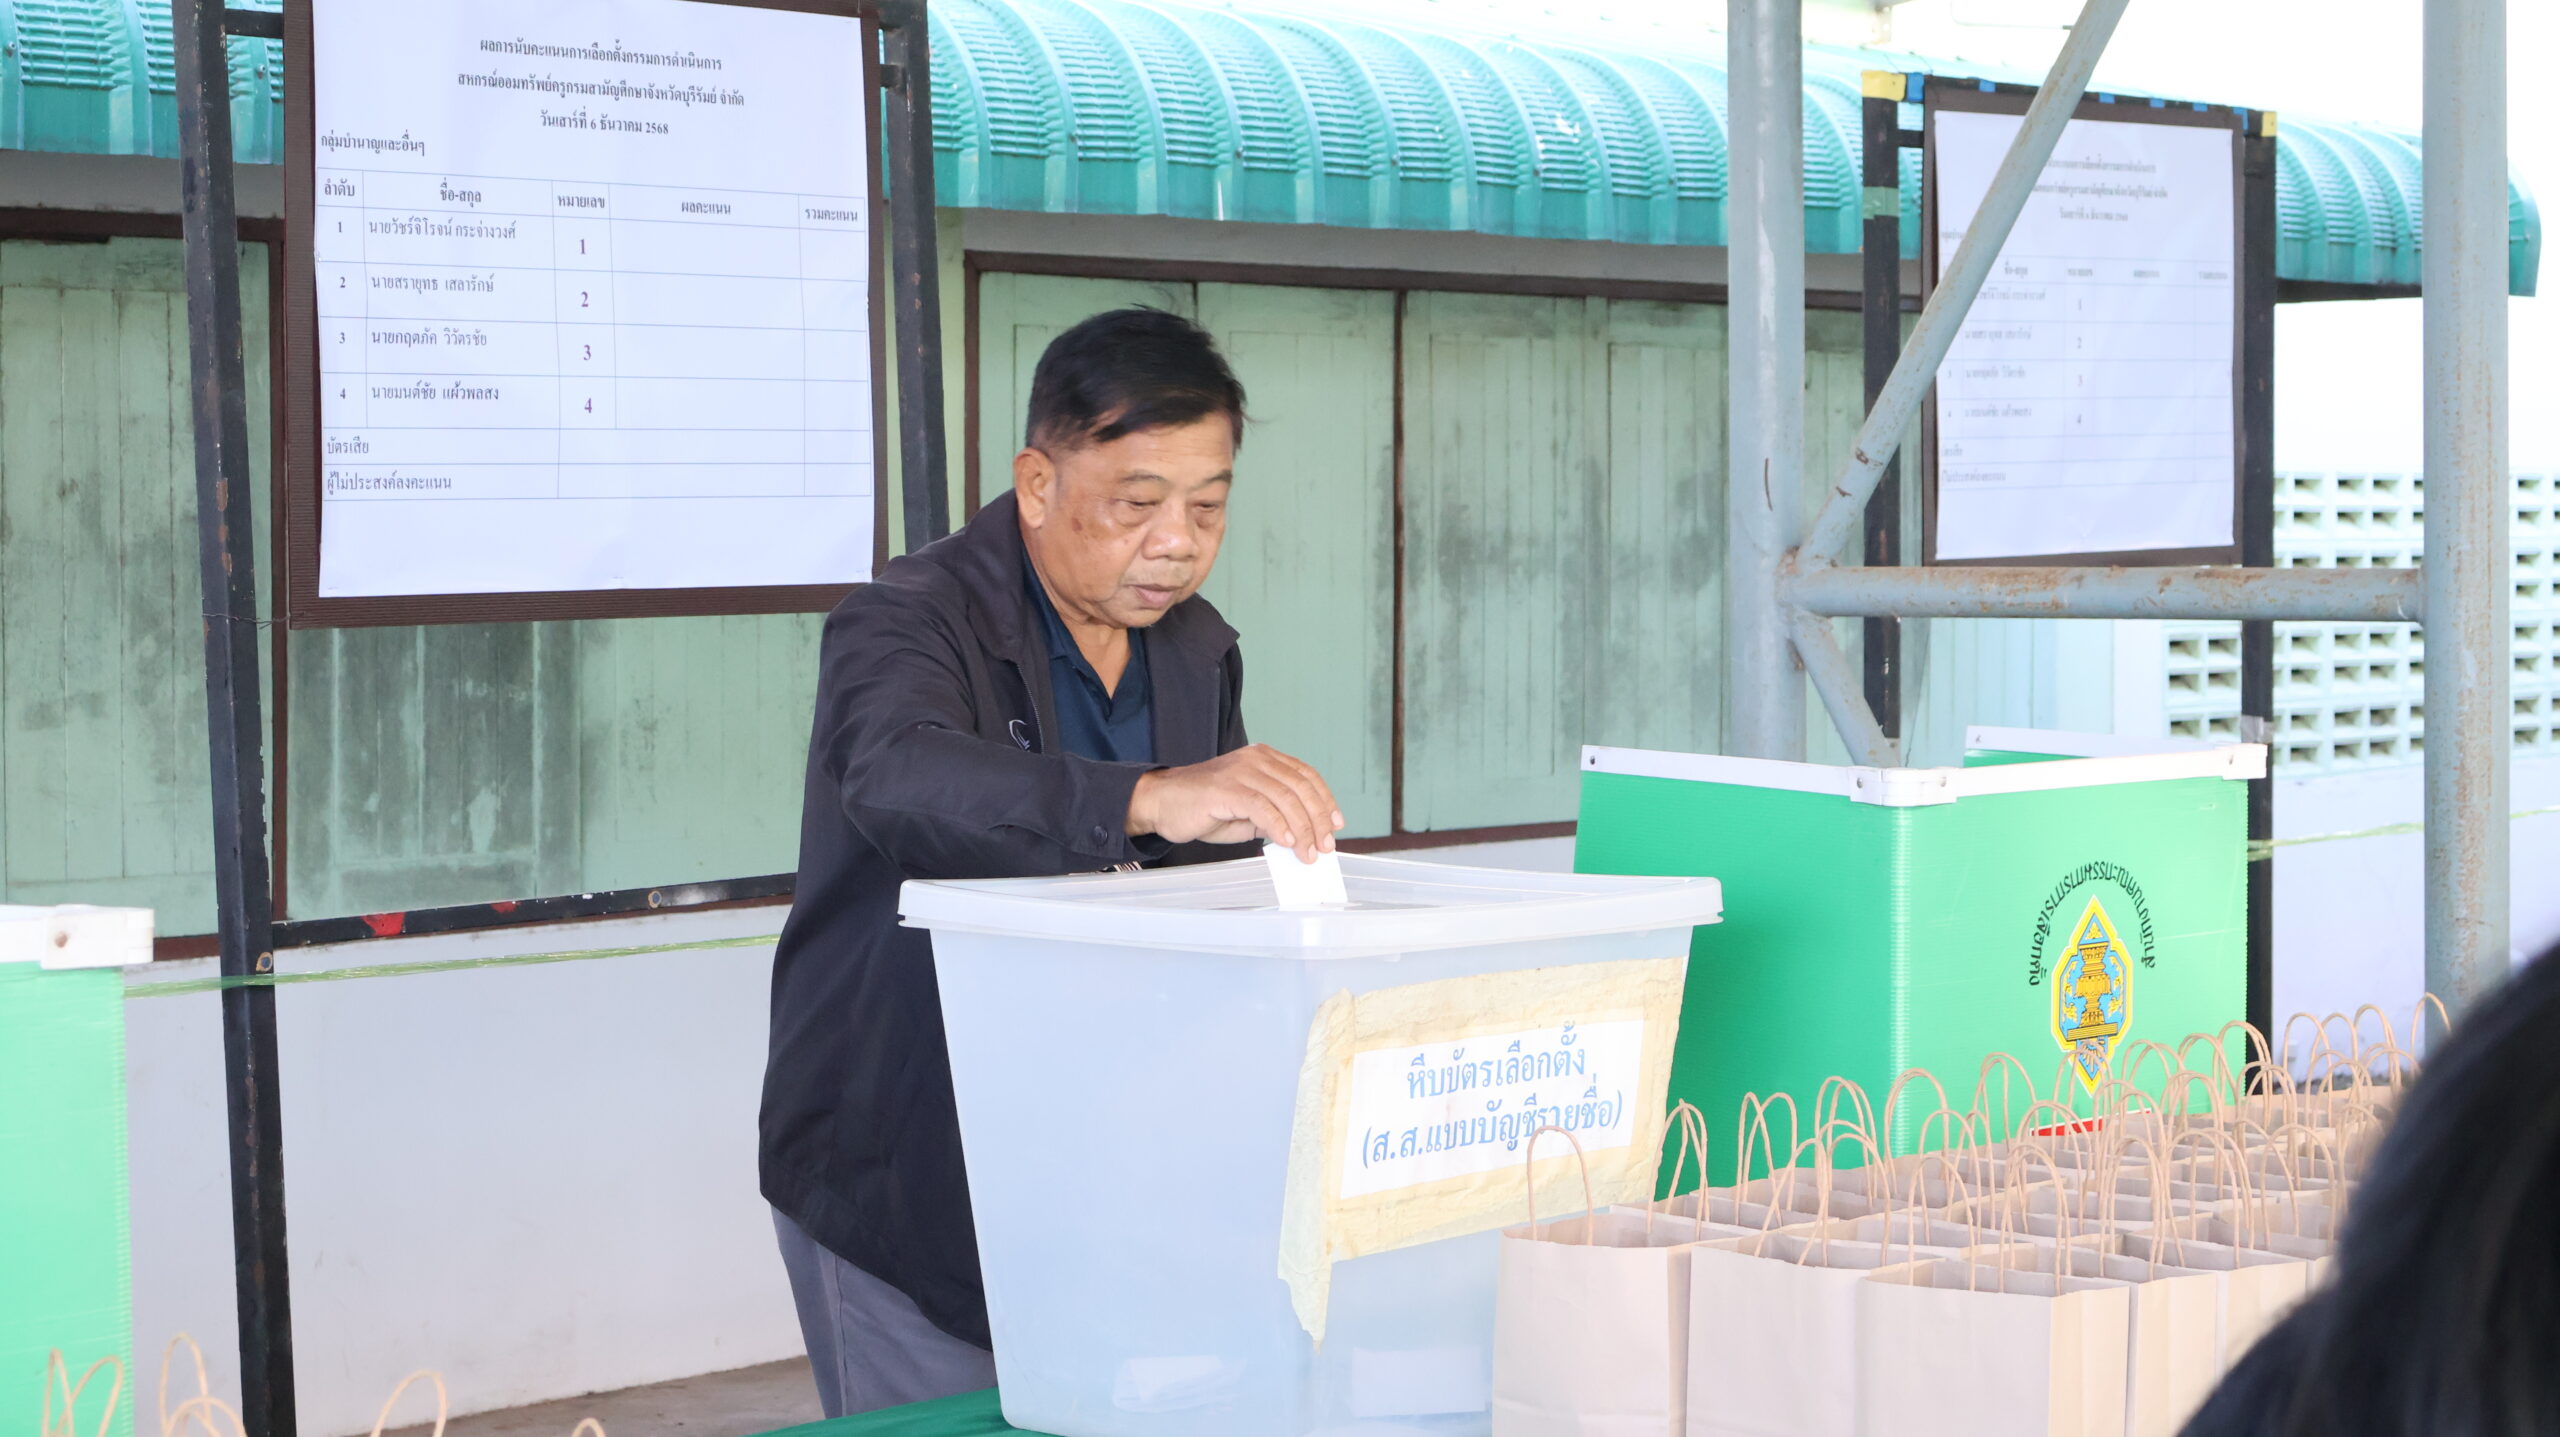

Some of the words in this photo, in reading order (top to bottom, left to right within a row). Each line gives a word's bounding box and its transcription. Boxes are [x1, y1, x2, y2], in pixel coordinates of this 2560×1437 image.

[480, 38, 722, 71] ผลการนับคะแนนการเลือกตั้งกรรมการดำเนินการ
[458, 70, 718, 107] สหกรณ์ออมทรัพย์ครูกรมสามัญศึกษาจังหวัดบุรีรัมย์
[720, 89, 745, 106] จำกัด
[540, 105, 588, 130] วันเสาร์ที่
[590, 118, 597, 130] 6
[600, 113, 643, 133] ธันวาคม
[645, 121, 669, 135] 2568
[320, 130, 426, 157] กลุ่มบำนาญและอื่นๆ
[323, 178, 356, 197] ลำดับ
[439, 177, 482, 208] ชื่อ-สกุล
[557, 194, 606, 209] หมายเลข
[680, 200, 732, 216] ผลคะแนน
[804, 207, 859, 222] รวมคะแนน
[337, 221, 344, 233] 1
[455, 219, 517, 239] กระจ่างวงศ์
[580, 238, 587, 255] 1
[339, 276, 347, 289] 2
[371, 276, 439, 295] นายสรายุทธ
[444, 272, 495, 293] เสลารักษ์
[581, 290, 590, 308] 2
[338, 331, 346, 344] 3
[583, 344, 592, 361] 3
[339, 388, 347, 400] 4
[371, 379, 437, 400] นายมนต์ชัย
[583, 397, 593, 414] 4
[327, 434, 370, 455] บัตรเสีย
[327, 470, 452, 496] ผู้ไม่ประสงค์ลงคะแนน
[2028, 860, 2156, 987] สำนักงานคณะกรรมการการเลือกตั้ง
[1406, 1020, 1587, 1101] หีบบัตรเลือกตั้ง
[1361, 1073, 1624, 1169] (ส.ส.แบบบัญชีรายชื่อ)
